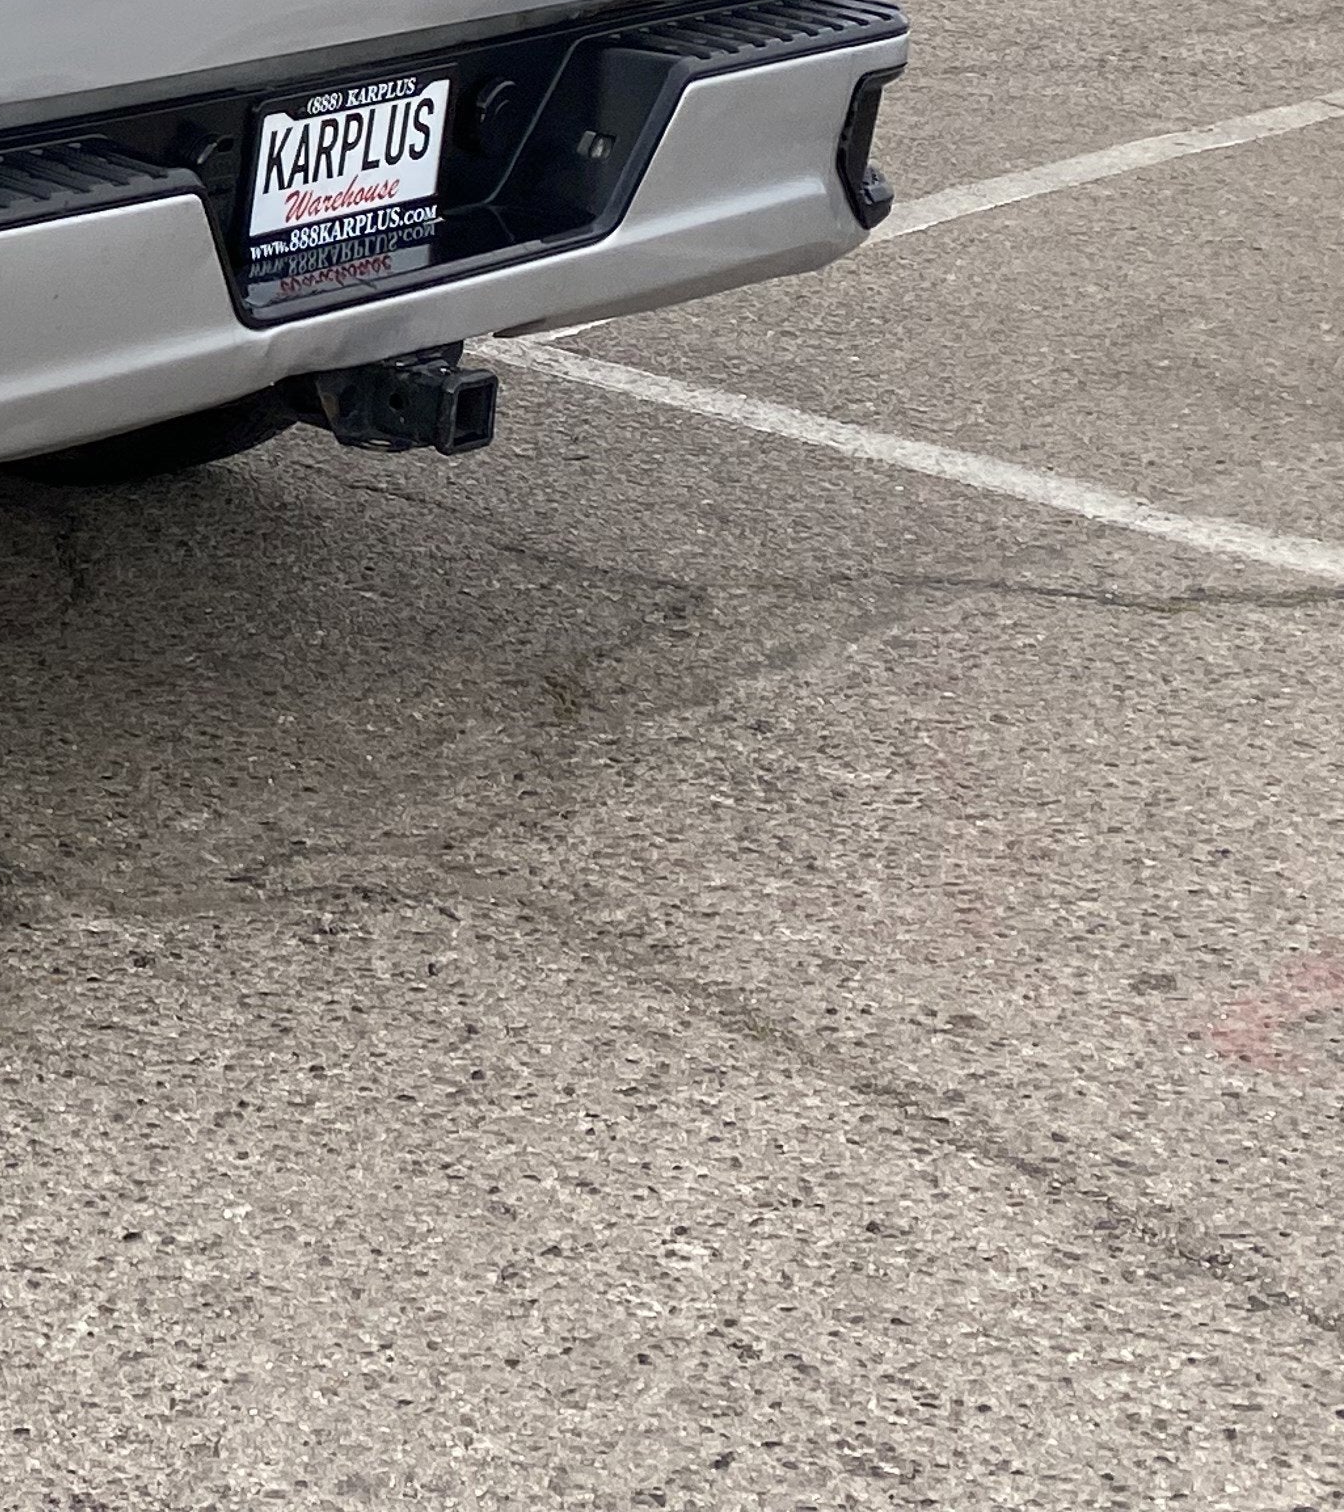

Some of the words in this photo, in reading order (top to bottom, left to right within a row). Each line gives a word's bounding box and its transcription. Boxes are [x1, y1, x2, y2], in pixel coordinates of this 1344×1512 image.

[306, 92, 343, 115] (888)
[345, 77, 417, 107] KARPLUS
[262, 97, 434, 195] KARPLUS
[284, 174, 401, 224] Warehouse
